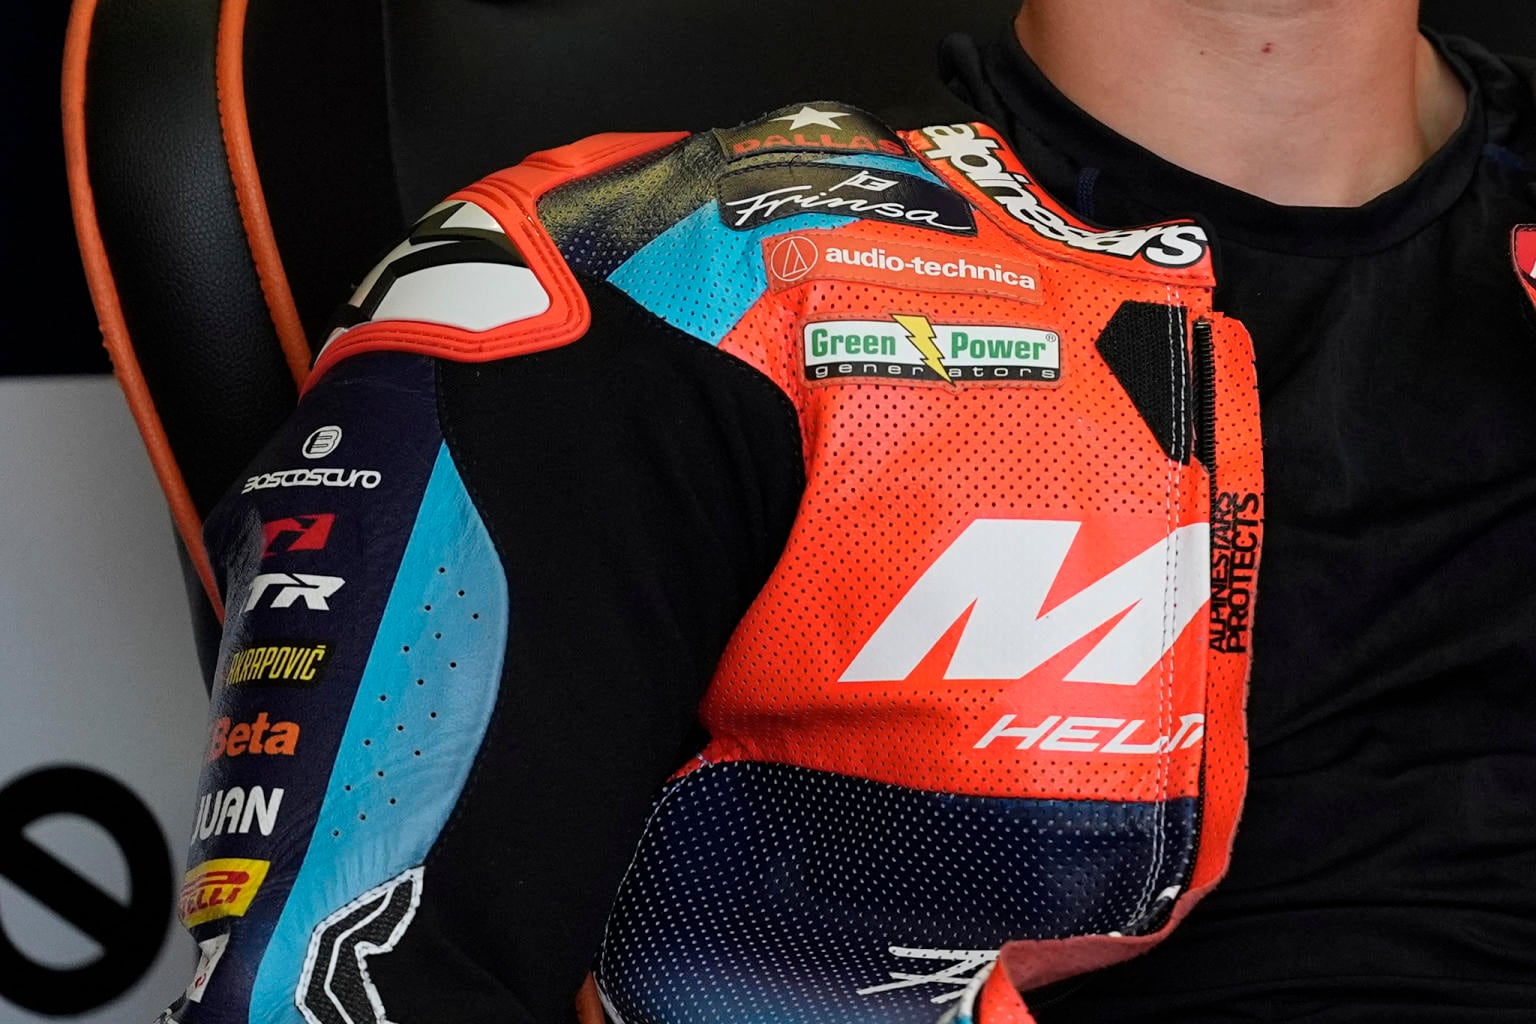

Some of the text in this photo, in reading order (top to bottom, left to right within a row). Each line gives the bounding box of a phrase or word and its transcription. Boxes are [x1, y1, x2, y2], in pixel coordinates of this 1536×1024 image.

[733, 133, 906, 155] DALLAS
[726, 184, 971, 227] Frinsa
[921, 123, 1208, 266] alpinestars
[825, 246, 1036, 290] audio-technica
[811, 329, 1046, 360] Green Power
[1209, 491, 1238, 654] ALPINESTARS
[1227, 492, 1259, 654] PROTECTS
[209, 712, 301, 761] Beta
